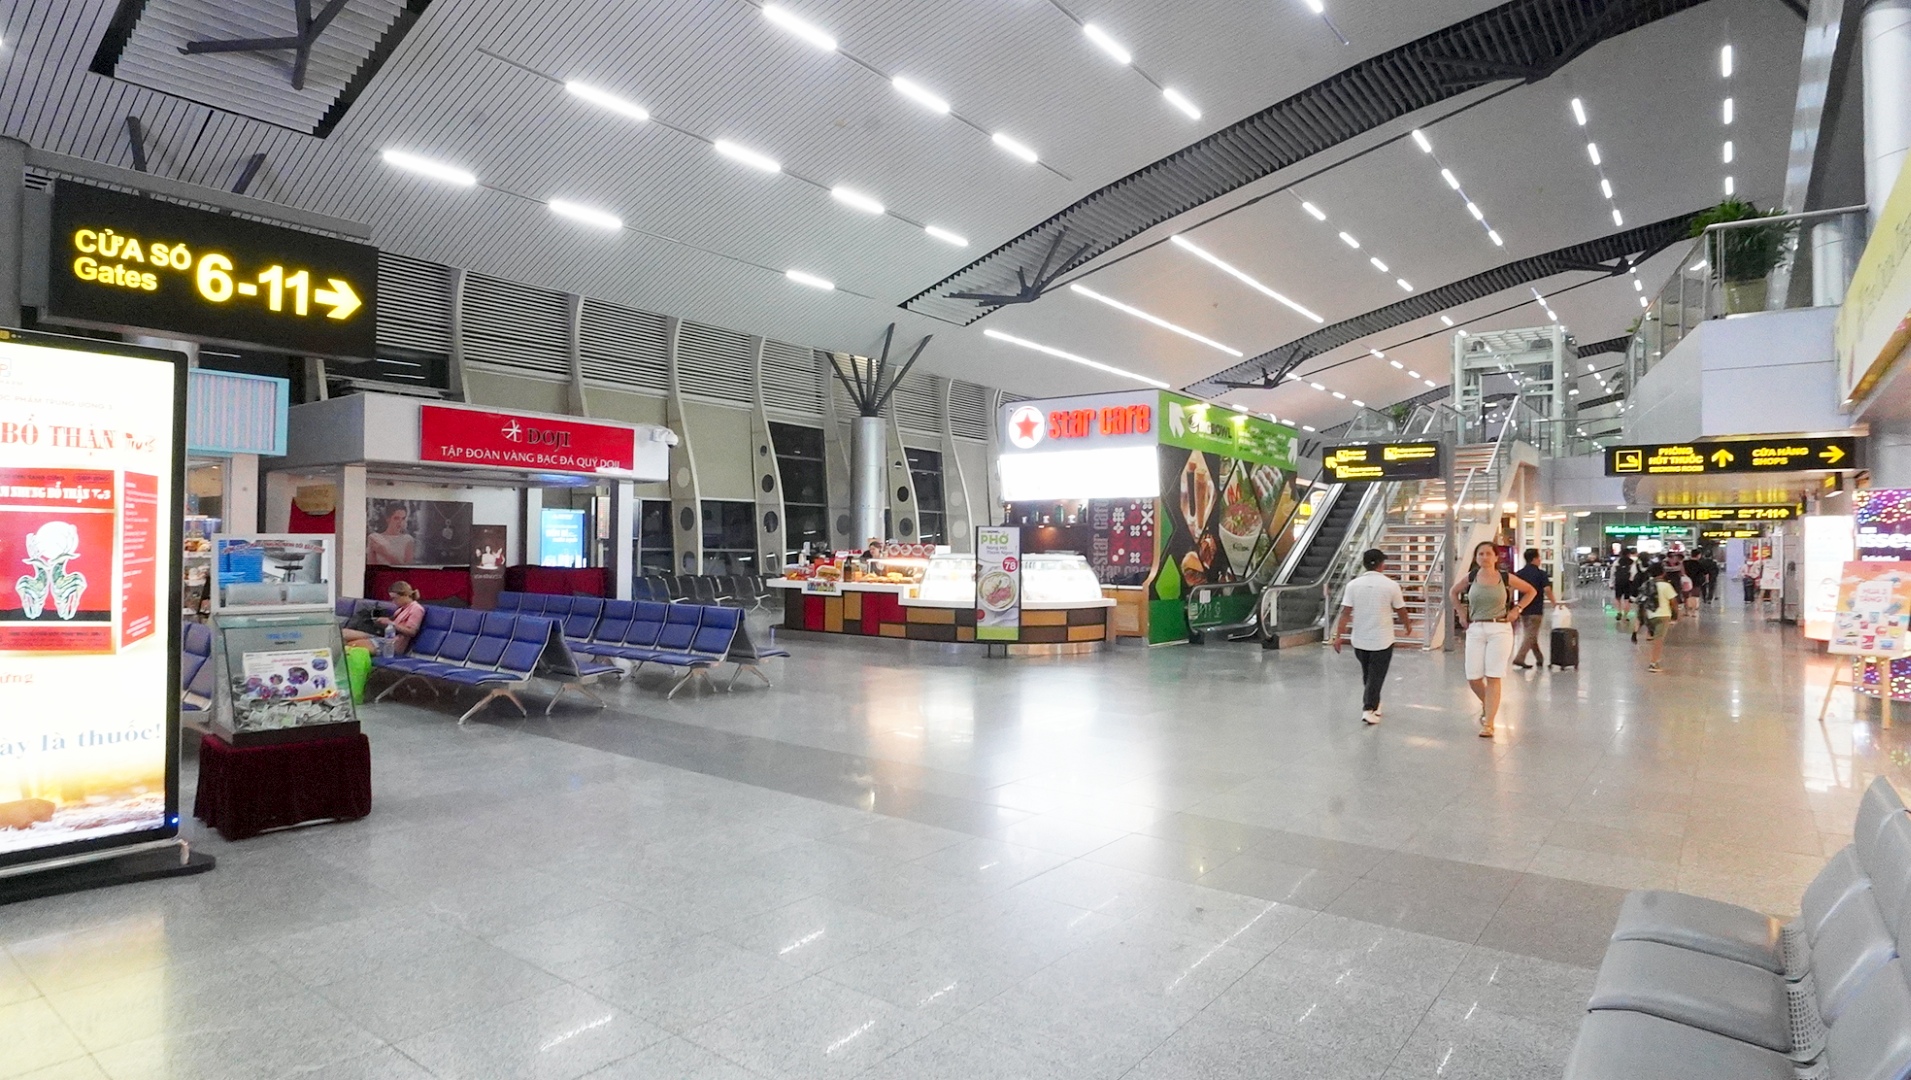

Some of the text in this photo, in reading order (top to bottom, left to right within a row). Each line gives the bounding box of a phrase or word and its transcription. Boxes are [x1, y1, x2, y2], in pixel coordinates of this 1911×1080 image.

[75, 228, 145, 263] CỬA
[74, 256, 158, 291] Gates
[197, 253, 309, 316] 6-11
[527, 428, 571, 451] DOJI
[441, 445, 463, 459] TẬP
[466, 447, 500, 460] ĐOÀN
[503, 450, 535, 463] VÀNG
[537, 454, 558, 467] BẠC
[560, 454, 575, 465] ĐÁ
[1752, 457, 1788, 465] SHOPS
[1004, 561, 1016, 571] 78
[42, 731, 66, 751] là
[78, 720, 161, 747] thuốc!
